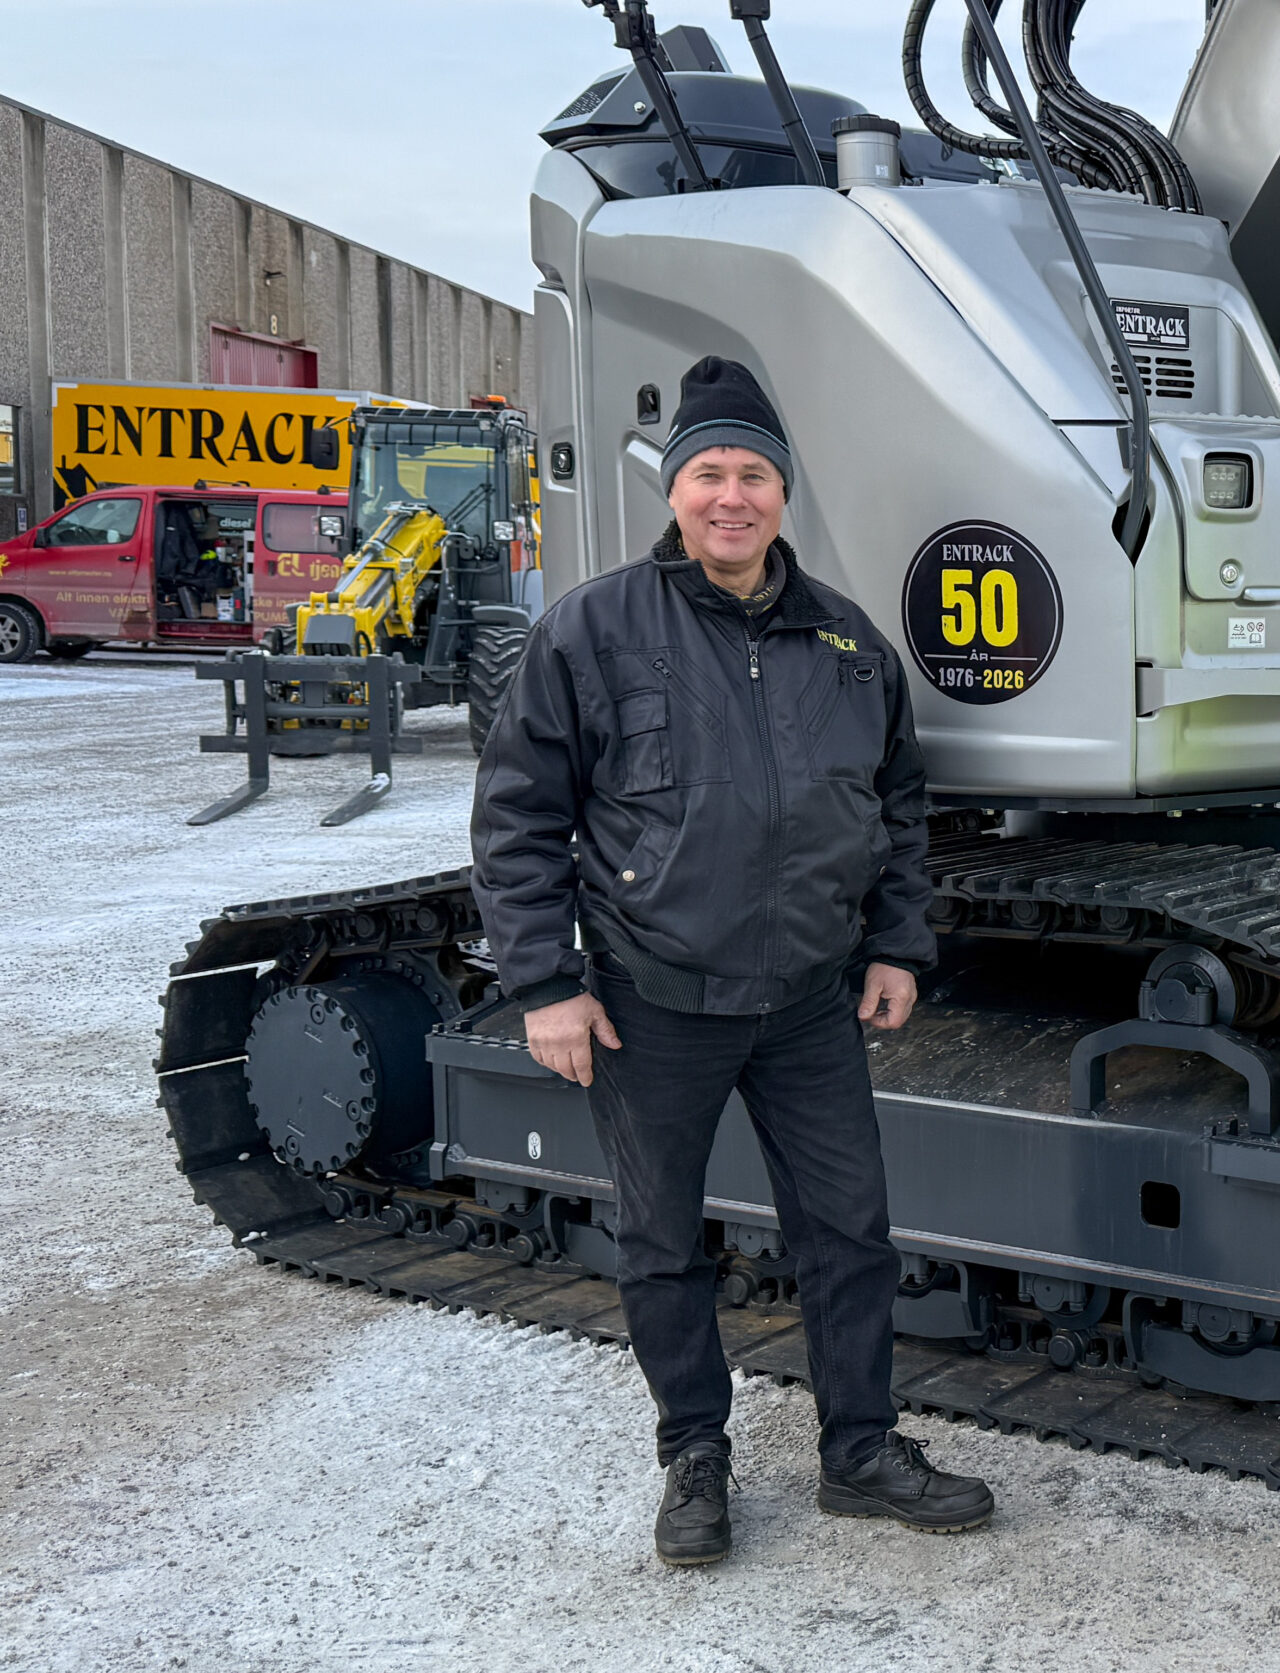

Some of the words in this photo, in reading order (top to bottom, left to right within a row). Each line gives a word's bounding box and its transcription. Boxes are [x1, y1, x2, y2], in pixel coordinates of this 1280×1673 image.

[1115, 313, 1186, 336] ENTRACK
[220, 518, 251, 528] diesel
[942, 544, 1014, 563] ENTRACK
[56, 592, 72, 603] Alt
[76, 592, 109, 604] innen
[941, 569, 1018, 647] 50
[816, 628, 858, 652] ENTRACK
[969, 649, 989, 661] ÅR
[939, 668, 1024, 689] 1976-2026
